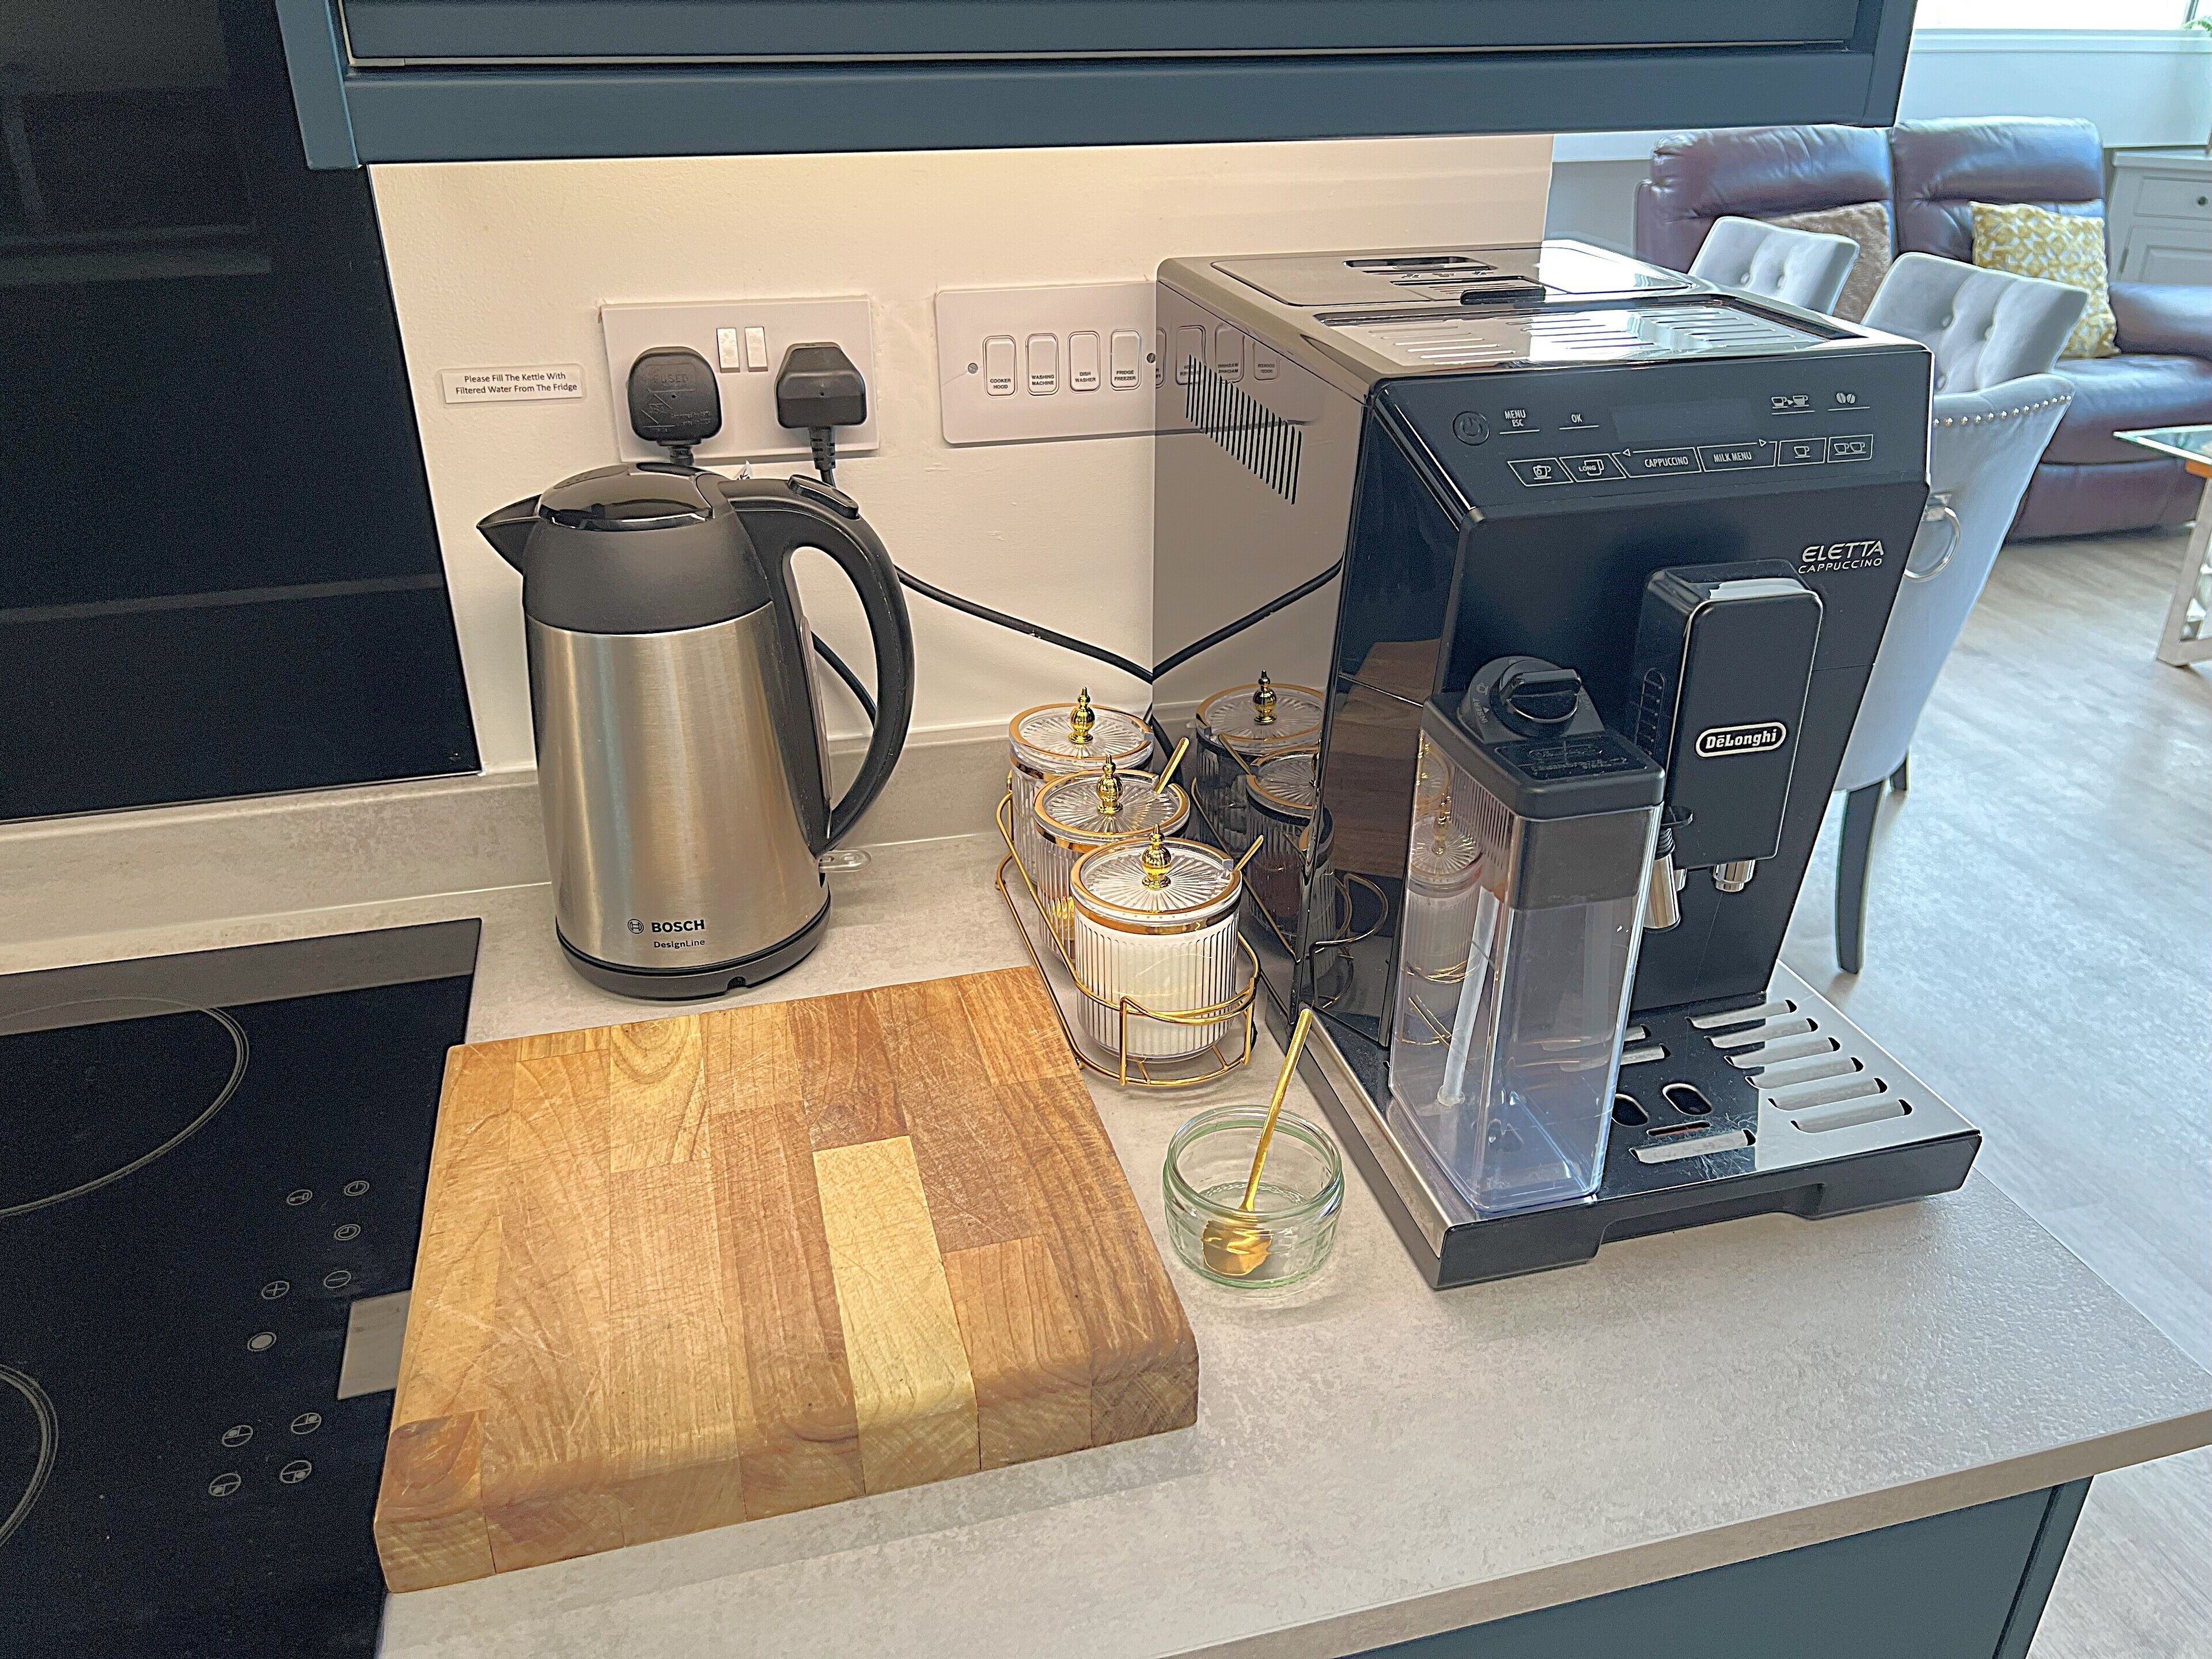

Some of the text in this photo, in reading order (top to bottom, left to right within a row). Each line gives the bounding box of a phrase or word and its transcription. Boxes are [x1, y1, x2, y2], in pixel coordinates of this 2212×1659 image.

[547, 372, 566, 380] With
[456, 386, 486, 395] Filtered
[553, 383, 577, 392] Fridge
[1505, 410, 1526, 419] MENU
[1571, 414, 1582, 423] OK
[1645, 456, 1689, 468] CAPPUCCINO
[1713, 452, 1752, 463] MILK MENU
[1802, 540, 1884, 563] ELETTA
[1798, 558, 1882, 574] CAPPUCCINO
[652, 919, 705, 933] BOSCH
[654, 939, 705, 949] DesignLine
